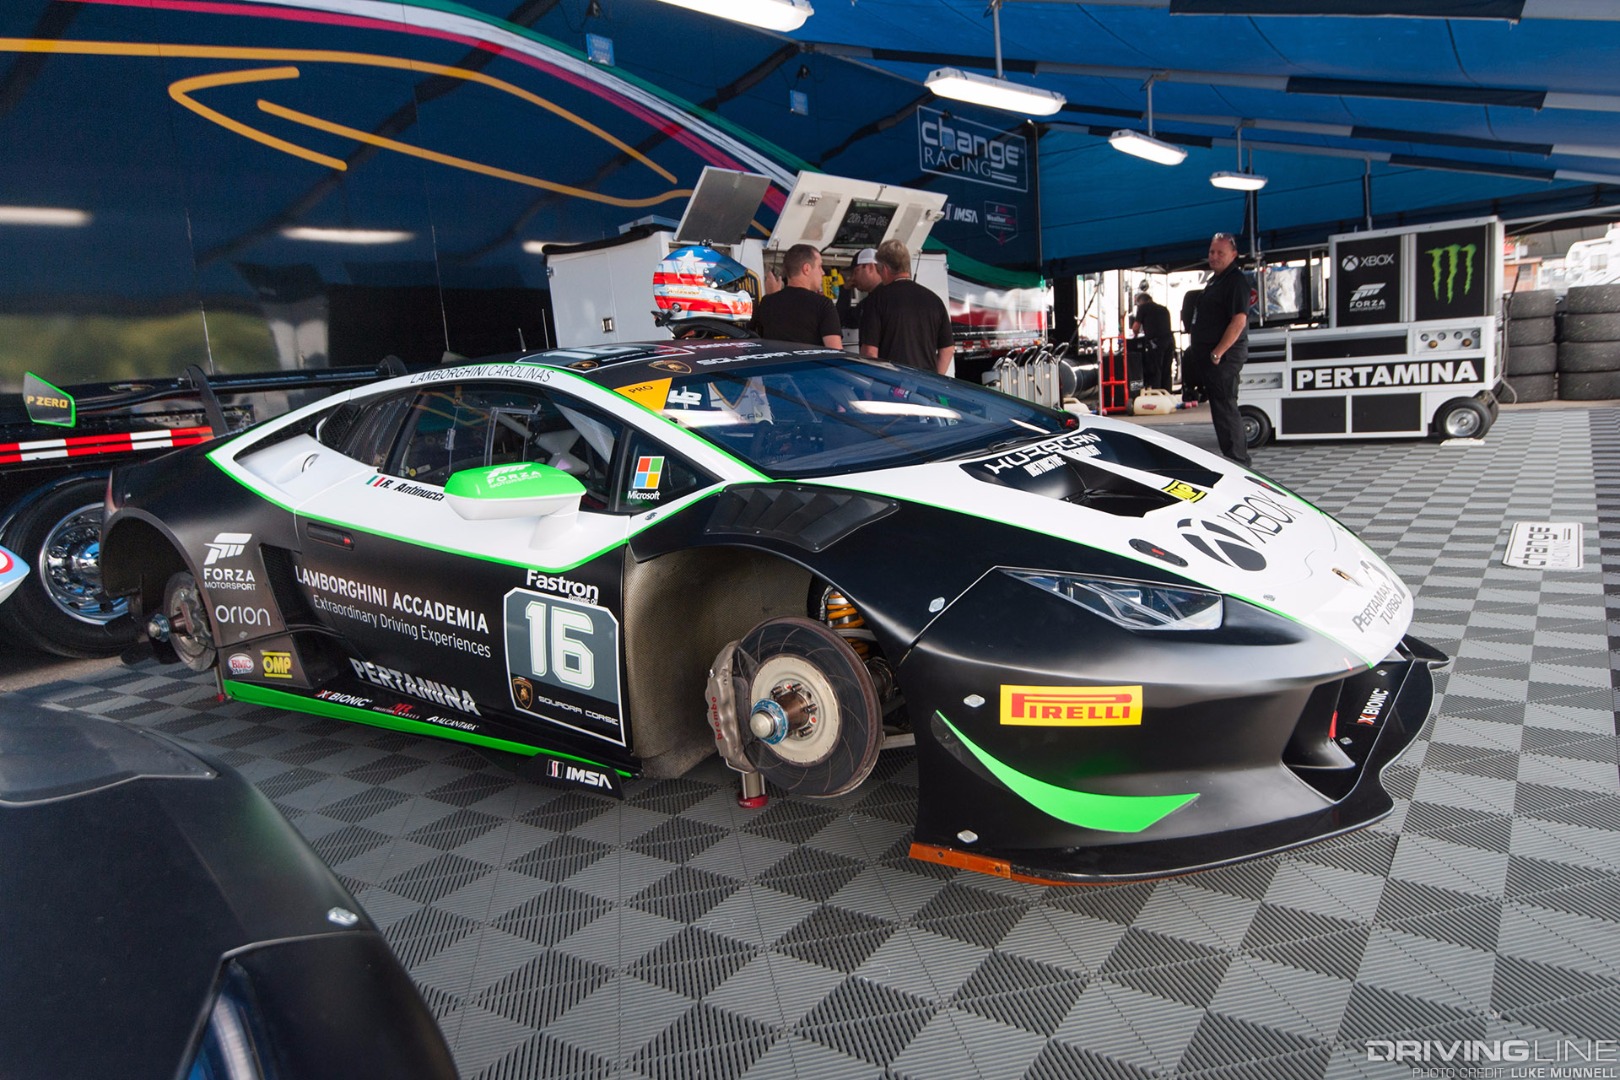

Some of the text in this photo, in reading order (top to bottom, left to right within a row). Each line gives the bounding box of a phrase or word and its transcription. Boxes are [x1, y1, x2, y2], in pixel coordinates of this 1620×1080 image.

[921, 117, 1019, 170] change
[924, 146, 991, 178] RACING
[953, 207, 978, 223] IMSA
[1360, 253, 1394, 268] XBOX
[1350, 299, 1386, 308] FORZA
[410, 365, 555, 384] LAMBORGHINI CAROLINAS
[1296, 360, 1479, 389] PERTAMINA
[26, 395, 69, 409] P ZERO
[628, 385, 654, 395] PRO
[984, 433, 1102, 475] HURACAN
[486, 470, 541, 484] FORZA
[380, 479, 445, 502] R. Antinucci
[627, 490, 660, 500] Microsoft
[1217, 490, 1303, 544] XBOX
[204, 567, 256, 582] FORZA
[204, 581, 256, 591] MOTORSPORT
[526, 568, 599, 600] Fastron
[294, 565, 490, 635] LAMBORGHINI ACCADEMIA
[1352, 581, 1393, 633] PERTAMAX
[1379, 593, 1403, 625] TURBO
[215, 604, 271, 627] orion
[313, 594, 492, 659] Extraordinary Driving Experiences
[525, 600, 595, 691] 16
[231, 659, 252, 669] BMC
[262, 656, 292, 674] OMP
[349, 657, 482, 717] PERTAMINA
[538, 695, 619, 726] SQUADRA CORSE
[711, 696, 723, 740] brembo
[1011, 692, 1133, 719] PIRELLI
[566, 766, 613, 790] IMSA
